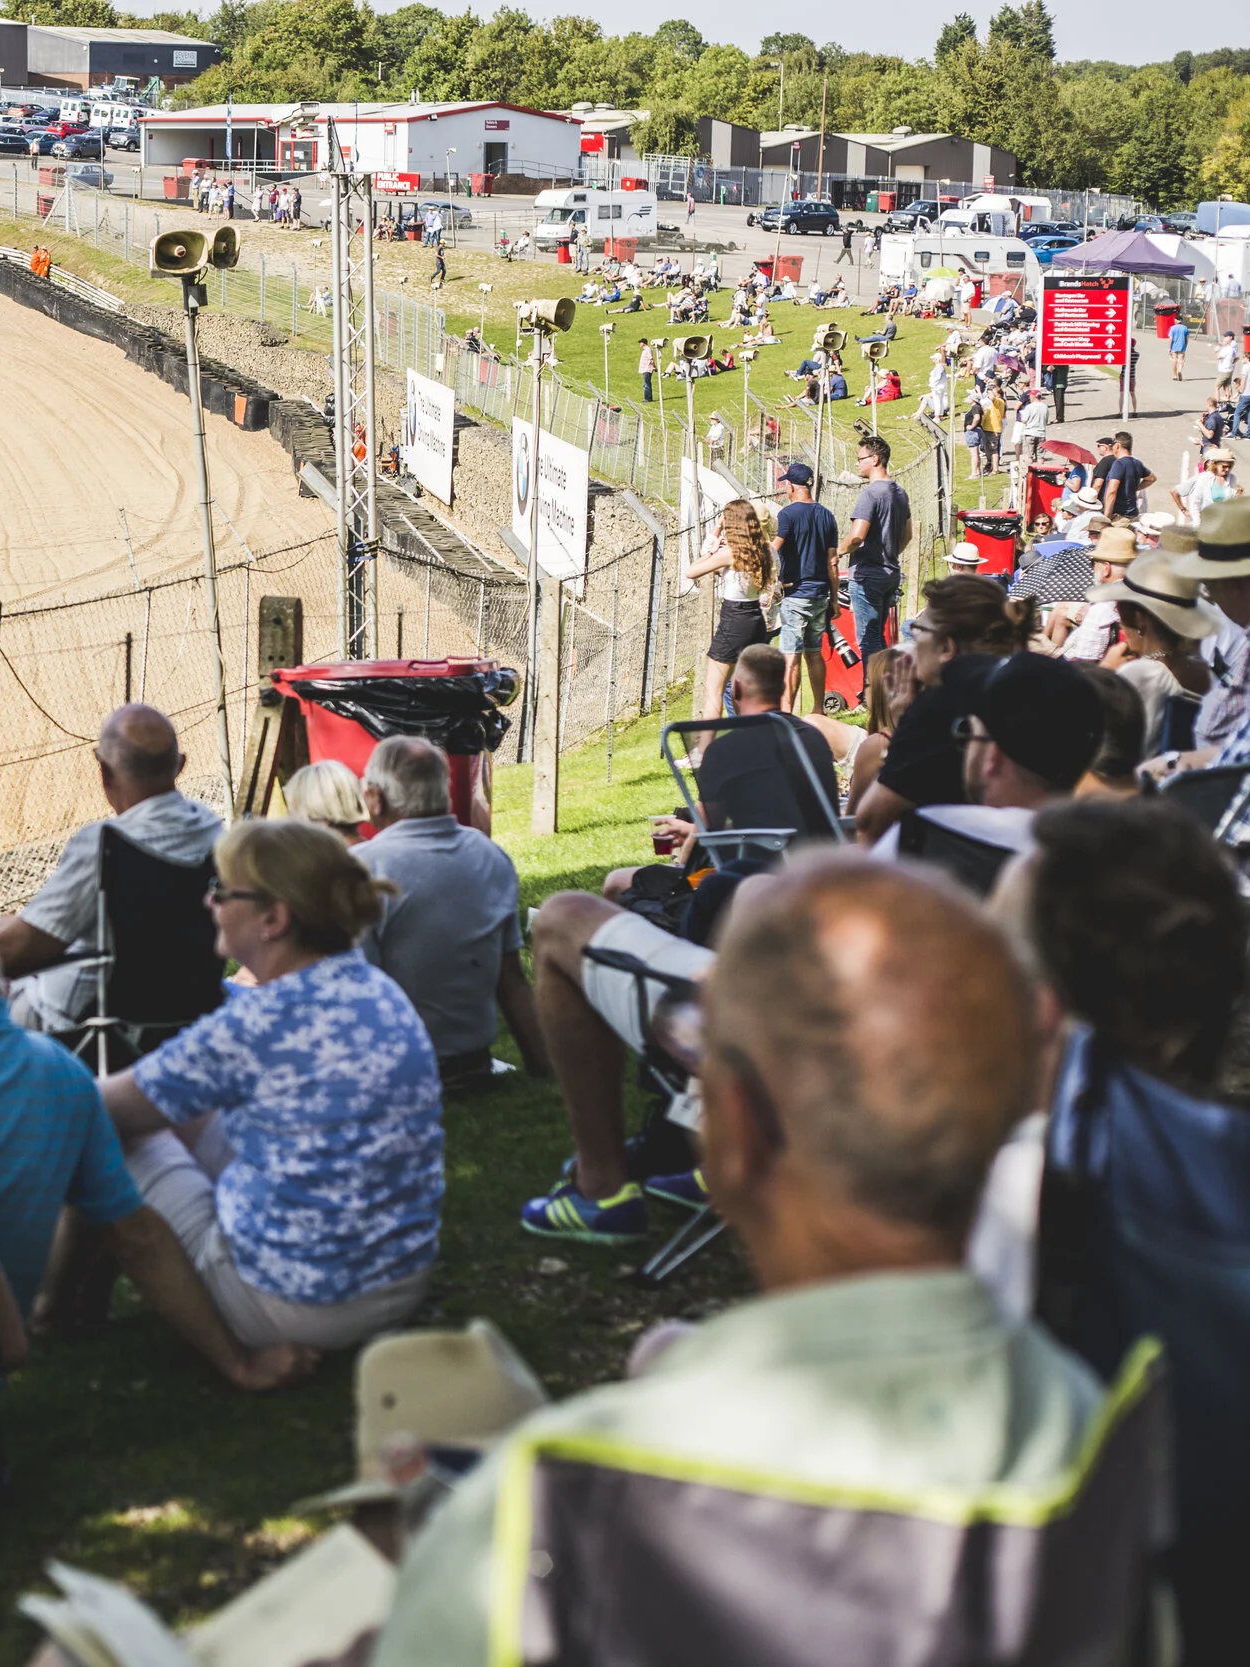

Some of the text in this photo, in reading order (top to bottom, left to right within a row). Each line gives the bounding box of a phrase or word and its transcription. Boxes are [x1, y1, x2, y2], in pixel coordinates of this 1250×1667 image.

[377, 172, 399, 181] PUBLIC
[377, 180, 411, 190] ENTRANCE
[425, 395, 441, 422] Ultimate
[418, 421, 445, 458] Driving Machine
[544, 453, 566, 490] Ultimate
[551, 497, 574, 537] Machine
